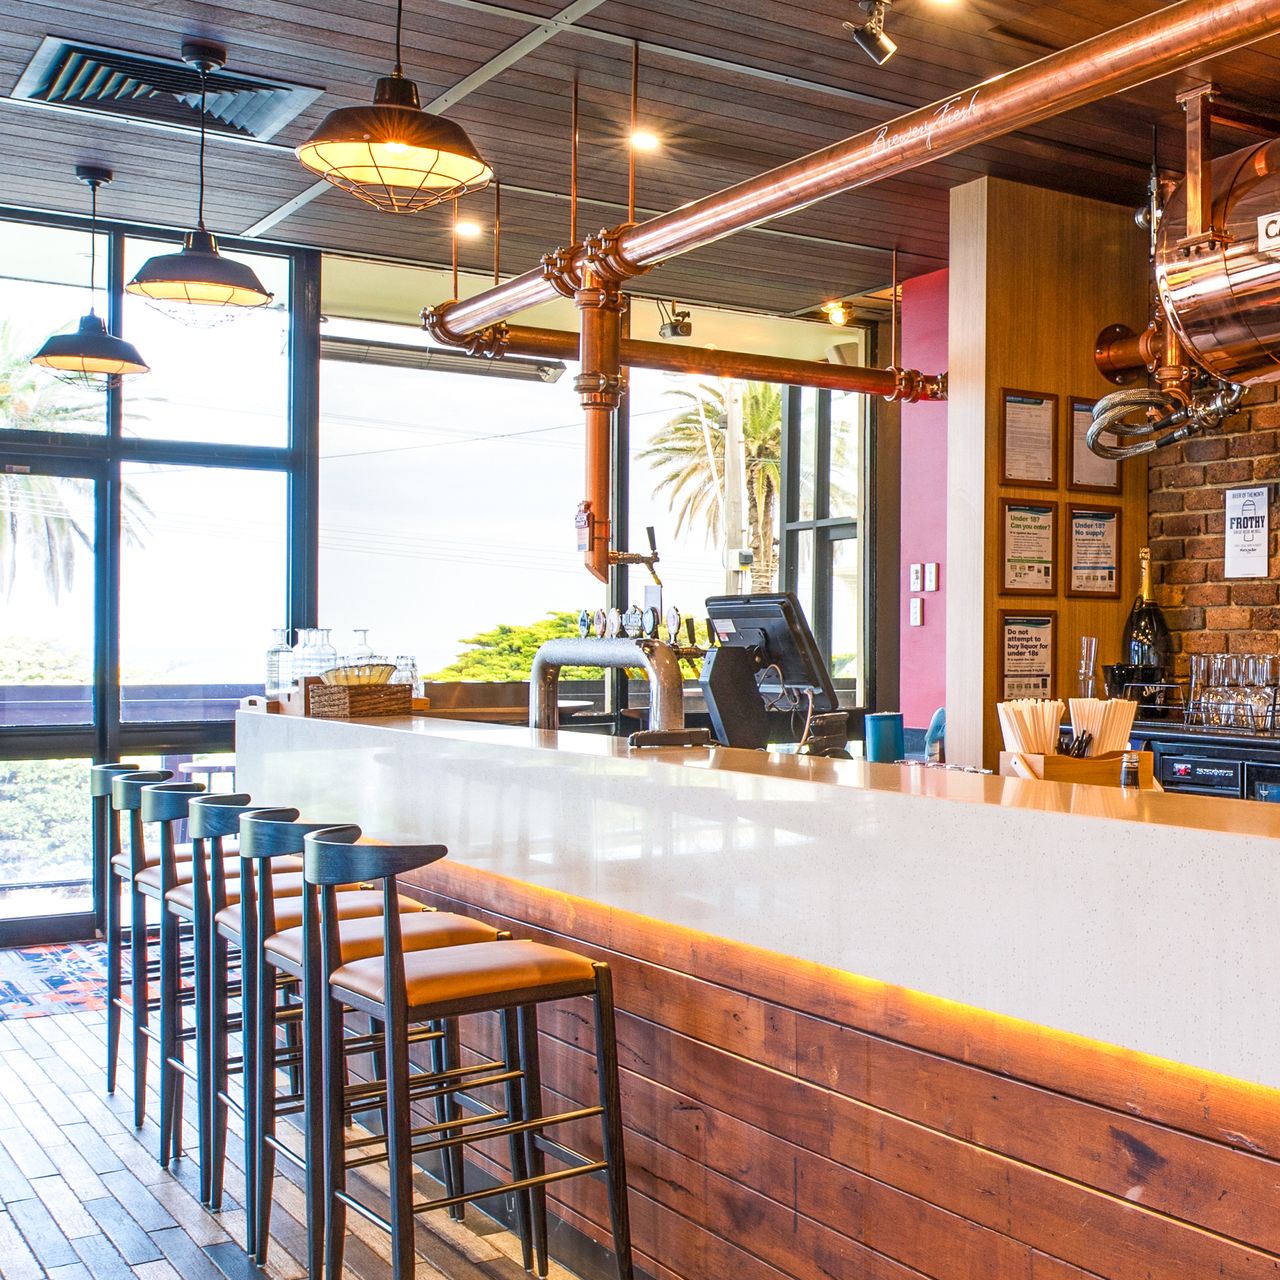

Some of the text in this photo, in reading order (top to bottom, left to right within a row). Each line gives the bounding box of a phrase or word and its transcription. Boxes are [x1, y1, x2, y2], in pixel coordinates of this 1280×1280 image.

[872, 90, 980, 155] Brewery Fresh
[1230, 515, 1265, 529] FROTHY
